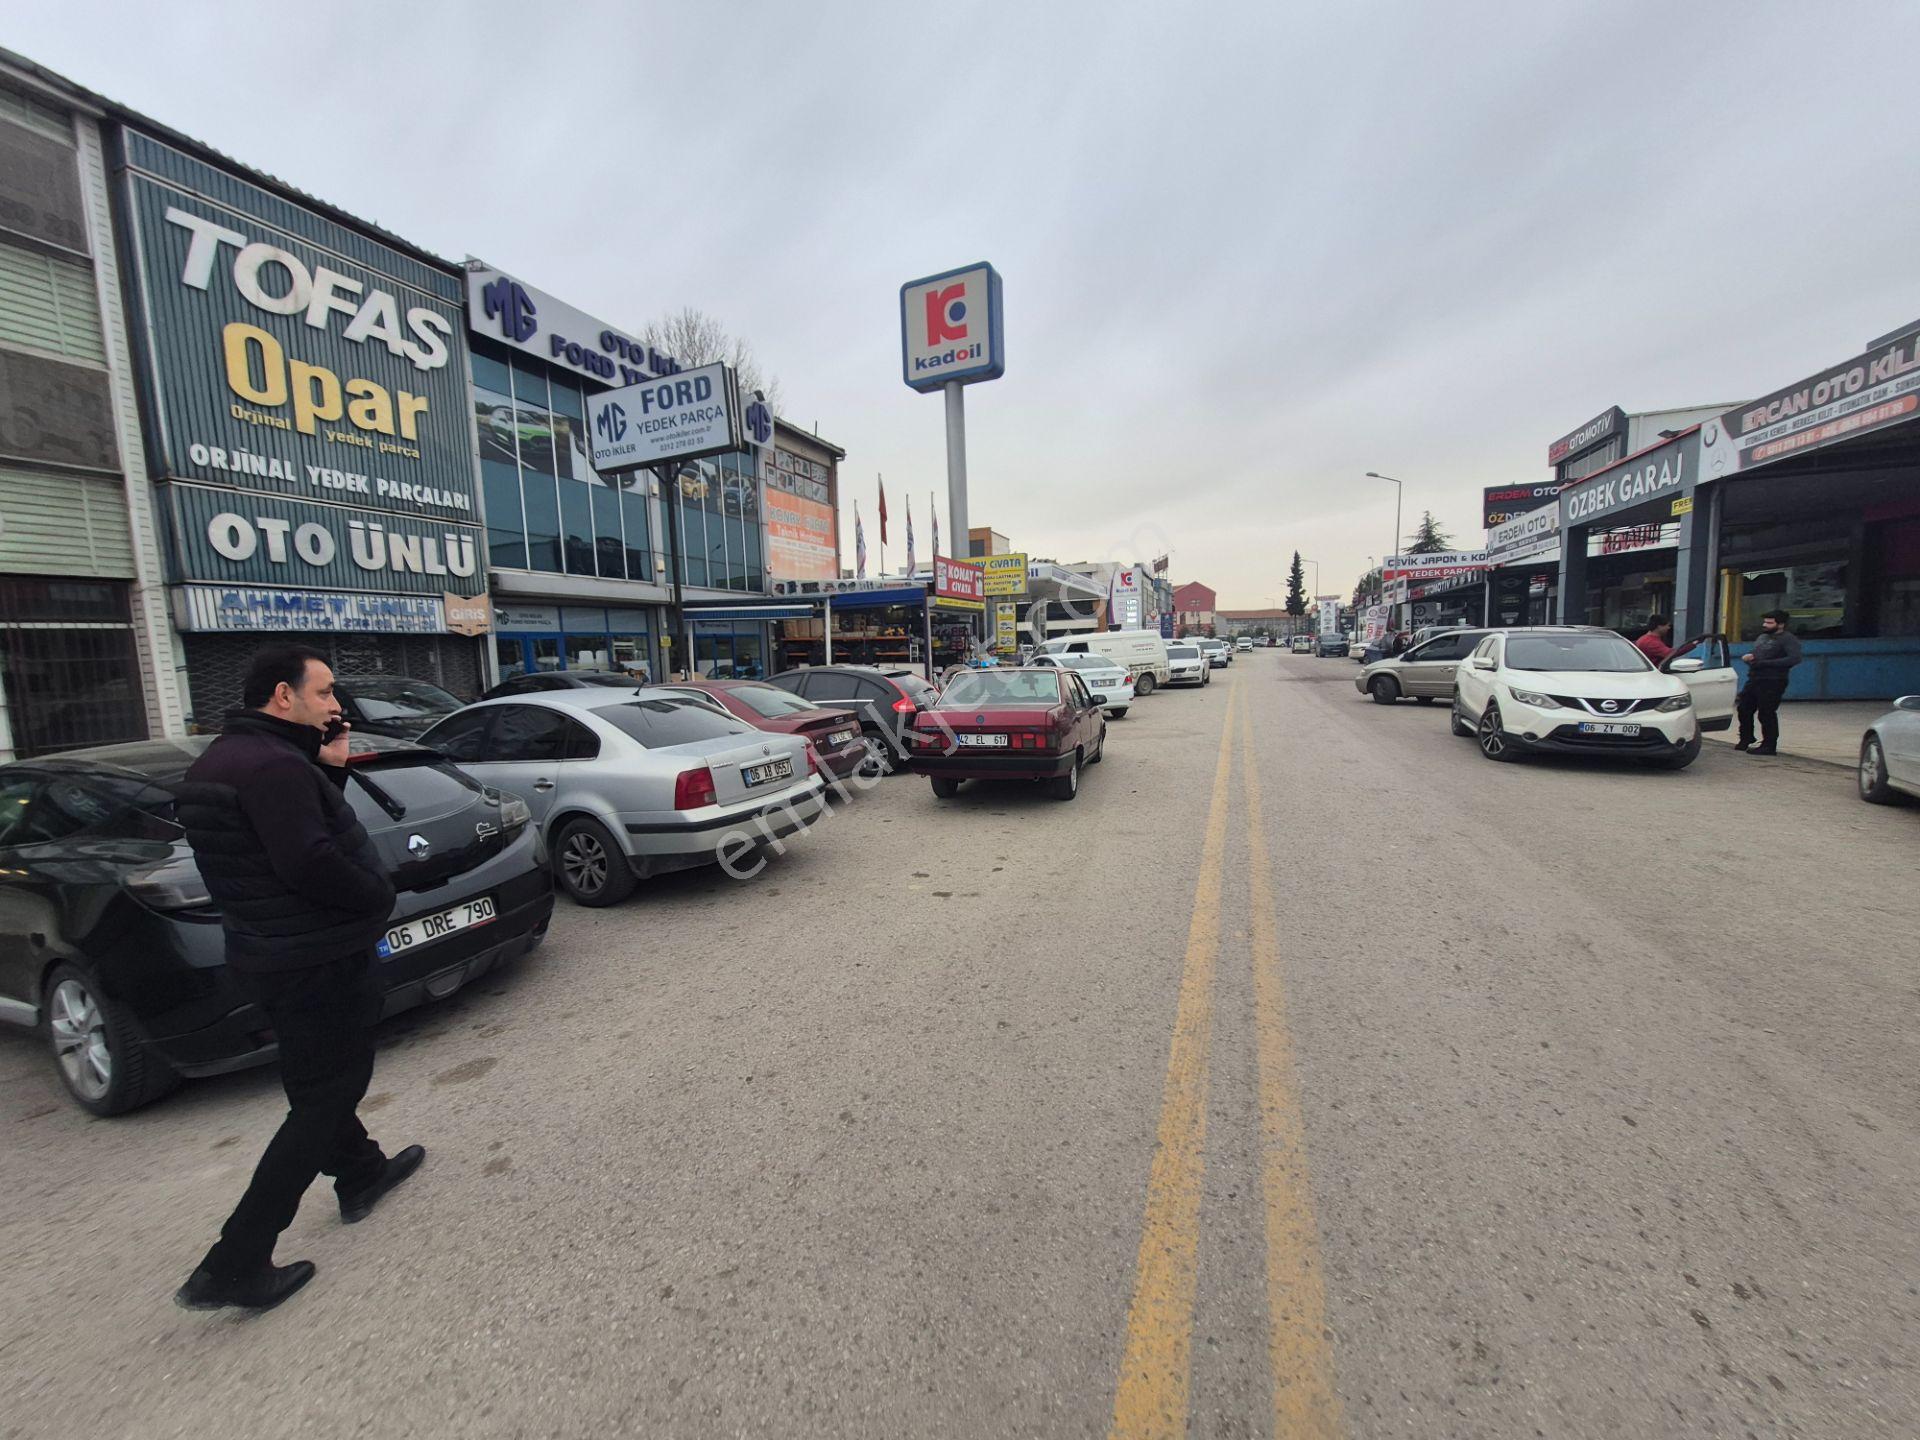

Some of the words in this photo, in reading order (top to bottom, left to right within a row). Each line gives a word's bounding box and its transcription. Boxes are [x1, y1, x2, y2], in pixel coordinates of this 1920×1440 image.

[165, 206, 454, 371] TOFAŞ
[483, 276, 537, 343] MG
[550, 334, 616, 380] FORD
[600, 329, 645, 366] OTO
[649, 346, 682, 376] İKİ
[915, 343, 981, 371] kadoil
[222, 322, 429, 440] Opar
[640, 375, 712, 414] FORD
[1741, 388, 1809, 434] ERCAN
[1812, 367, 1865, 406] OTO
[231, 404, 292, 431] Orjinal
[597, 402, 628, 443] MG
[636, 415, 678, 435] YEDEK
[681, 405, 724, 426] PARÇA
[746, 401, 772, 444] MG
[324, 429, 374, 449] yedek
[379, 440, 420, 459] parça
[595, 448, 611, 460] OTO
[612, 443, 637, 457] İKİLER
[190, 443, 297, 483] ORJİNAL
[306, 464, 370, 495] YEDEK
[377, 478, 470, 510] PARÇALARI
[1568, 479, 1616, 521] ÖZBEK
[1619, 452, 1684, 502] GARAJ
[1488, 489, 1531, 501] ERDEM
[1533, 486, 1561, 497] OTO
[1498, 523, 1526, 543] ERDEM
[1527, 515, 1547, 533] OTO
[207, 512, 335, 567] OTO
[348, 519, 476, 578] ÜNLÜ
[948, 563, 974, 583] KONAY
[990, 558, 1021, 569] CİVATA
[1388, 556, 1418, 567] ÇEVİK
[1422, 555, 1457, 565] JAPON
[1409, 569, 1441, 578] YEDEK
[1443, 567, 1475, 576] PAR
[952, 582, 972, 595] CİVATA
[218, 590, 348, 614] AHMET
[358, 596, 436, 618] ÜNLÜ
[959, 734, 969, 745] 42
[976, 734, 985, 745] EL
[1584, 724, 1595, 732] 06
[1603, 725, 1615, 733] ZY
[1622, 726, 1639, 734] 002
[750, 768, 760, 781] 06
[764, 765, 773, 778] AB
[775, 760, 791, 776] 0557
[387, 926, 413, 950] 06
[422, 911, 457, 939] DRE
[463, 899, 493, 923] 790
